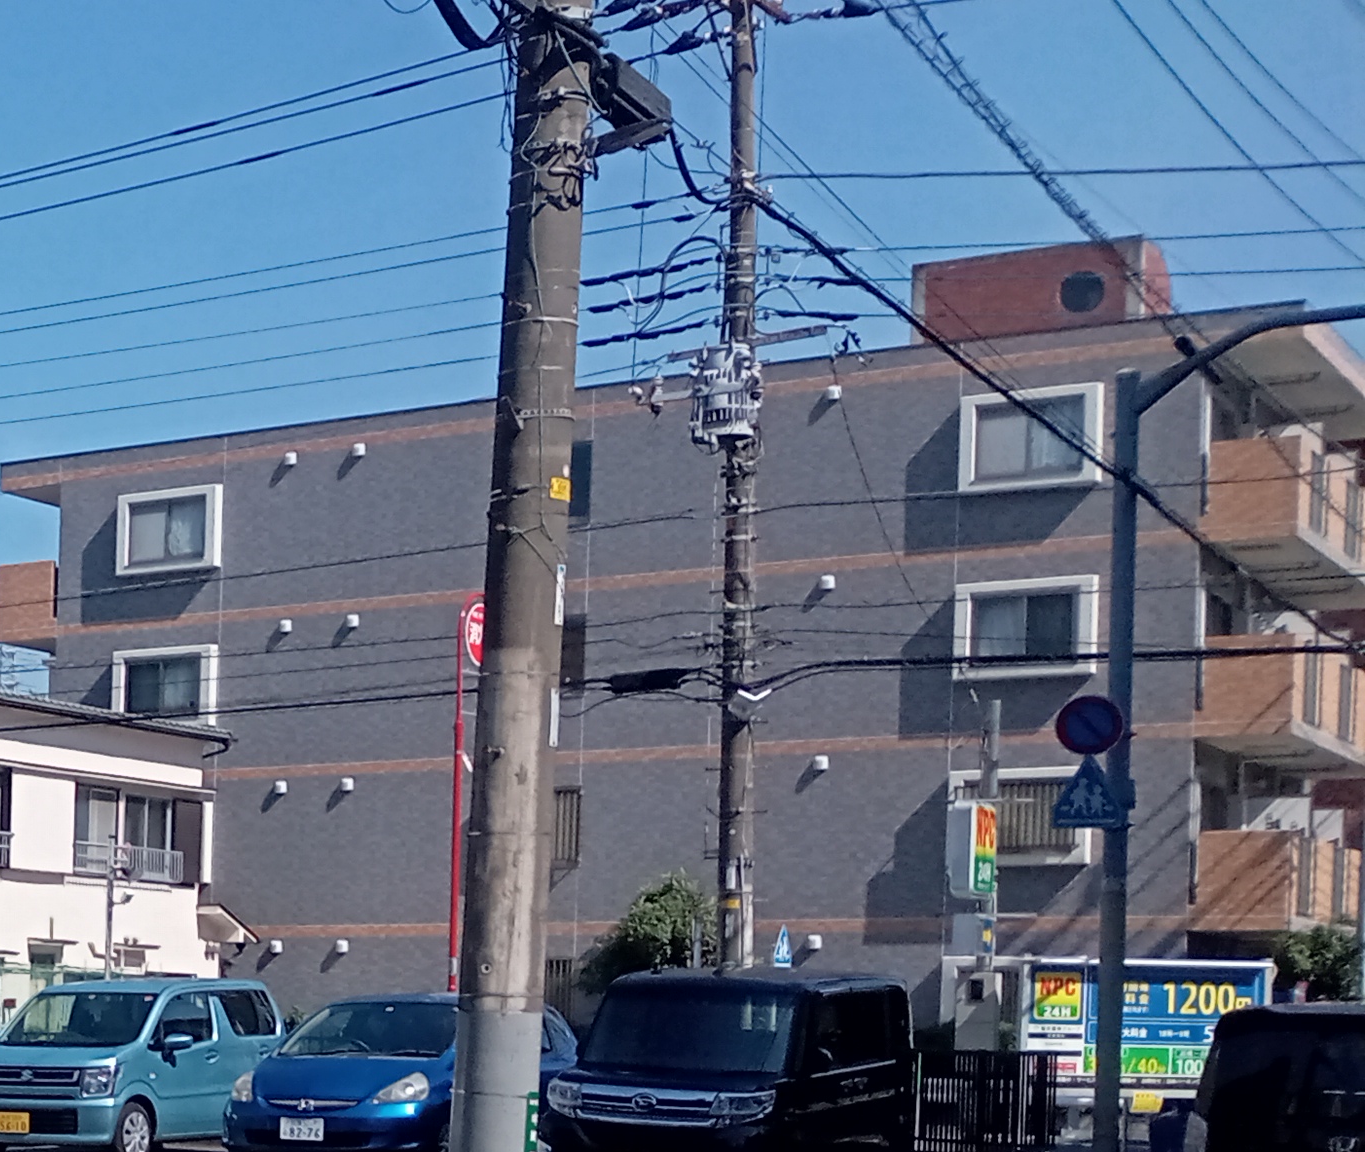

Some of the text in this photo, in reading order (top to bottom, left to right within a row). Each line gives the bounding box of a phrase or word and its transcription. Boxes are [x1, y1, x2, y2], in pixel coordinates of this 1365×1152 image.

[1040, 976, 1076, 997] NPC
[1043, 1005, 1071, 1018] 24H
[289, 1127, 321, 1139] 82-76
